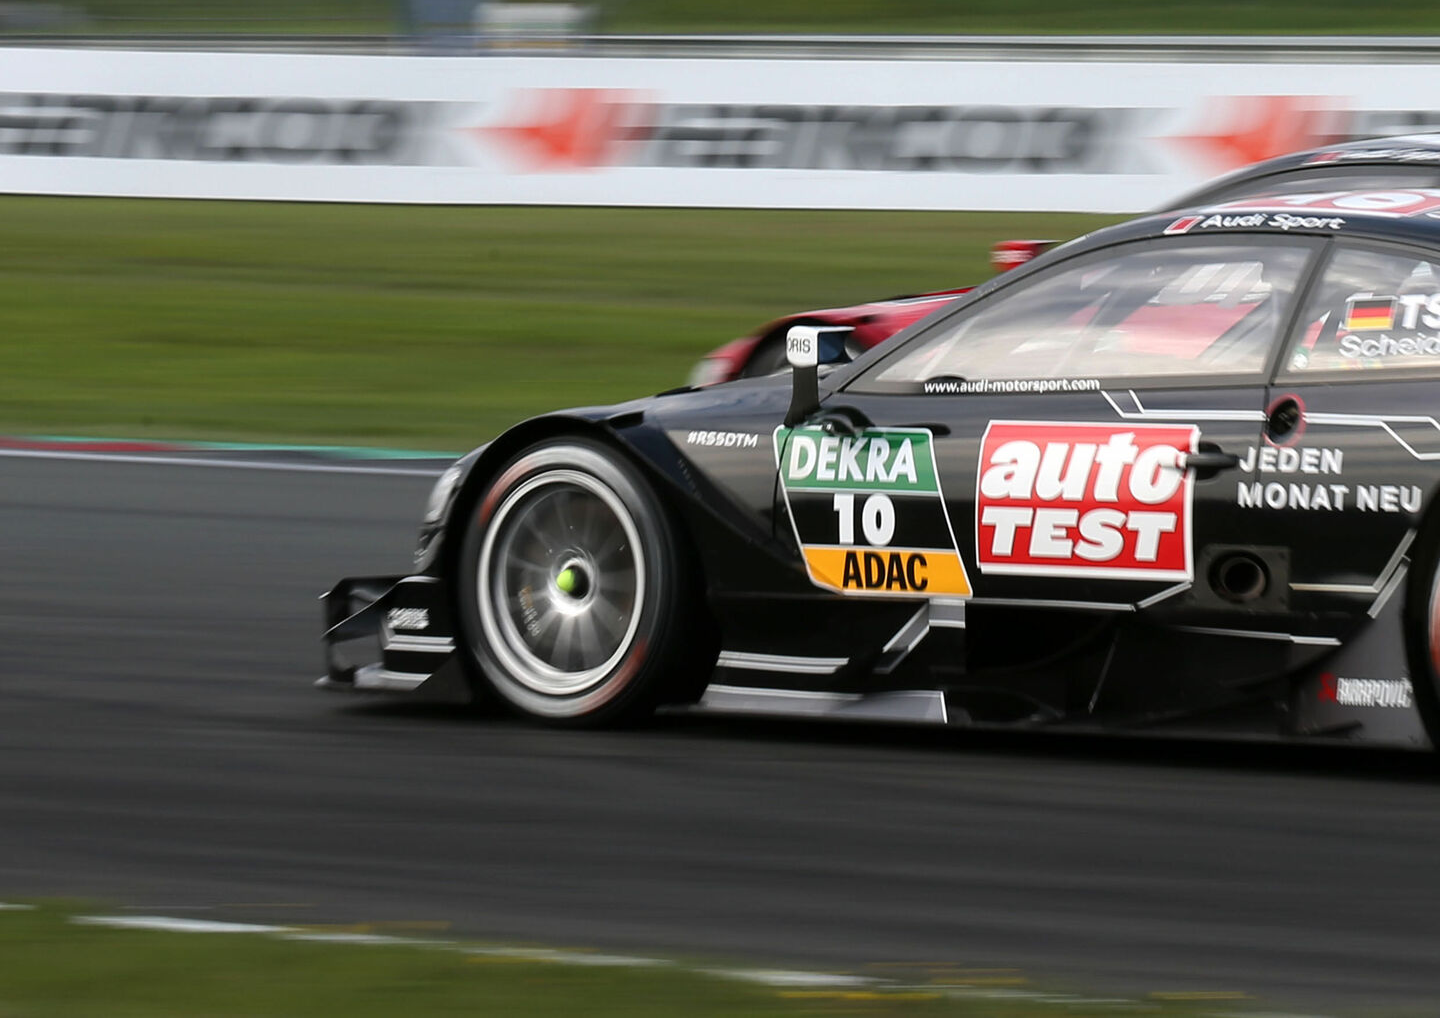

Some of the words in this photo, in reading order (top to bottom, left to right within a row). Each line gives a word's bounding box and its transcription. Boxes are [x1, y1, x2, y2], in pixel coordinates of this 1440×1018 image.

[1201, 212, 1267, 229] Audi
[1268, 213, 1346, 231] Sport
[924, 379, 1100, 394] www.audi-motorsport.com
[788, 435, 919, 483] DEKRA
[981, 433, 1187, 504] auto
[1239, 446, 1344, 475] JEDEN
[1237, 482, 1349, 511] MONAT
[1356, 485, 1423, 514] NEU
[833, 493, 896, 546] 10
[981, 507, 1177, 562] TEST
[842, 551, 928, 591] ADAC
